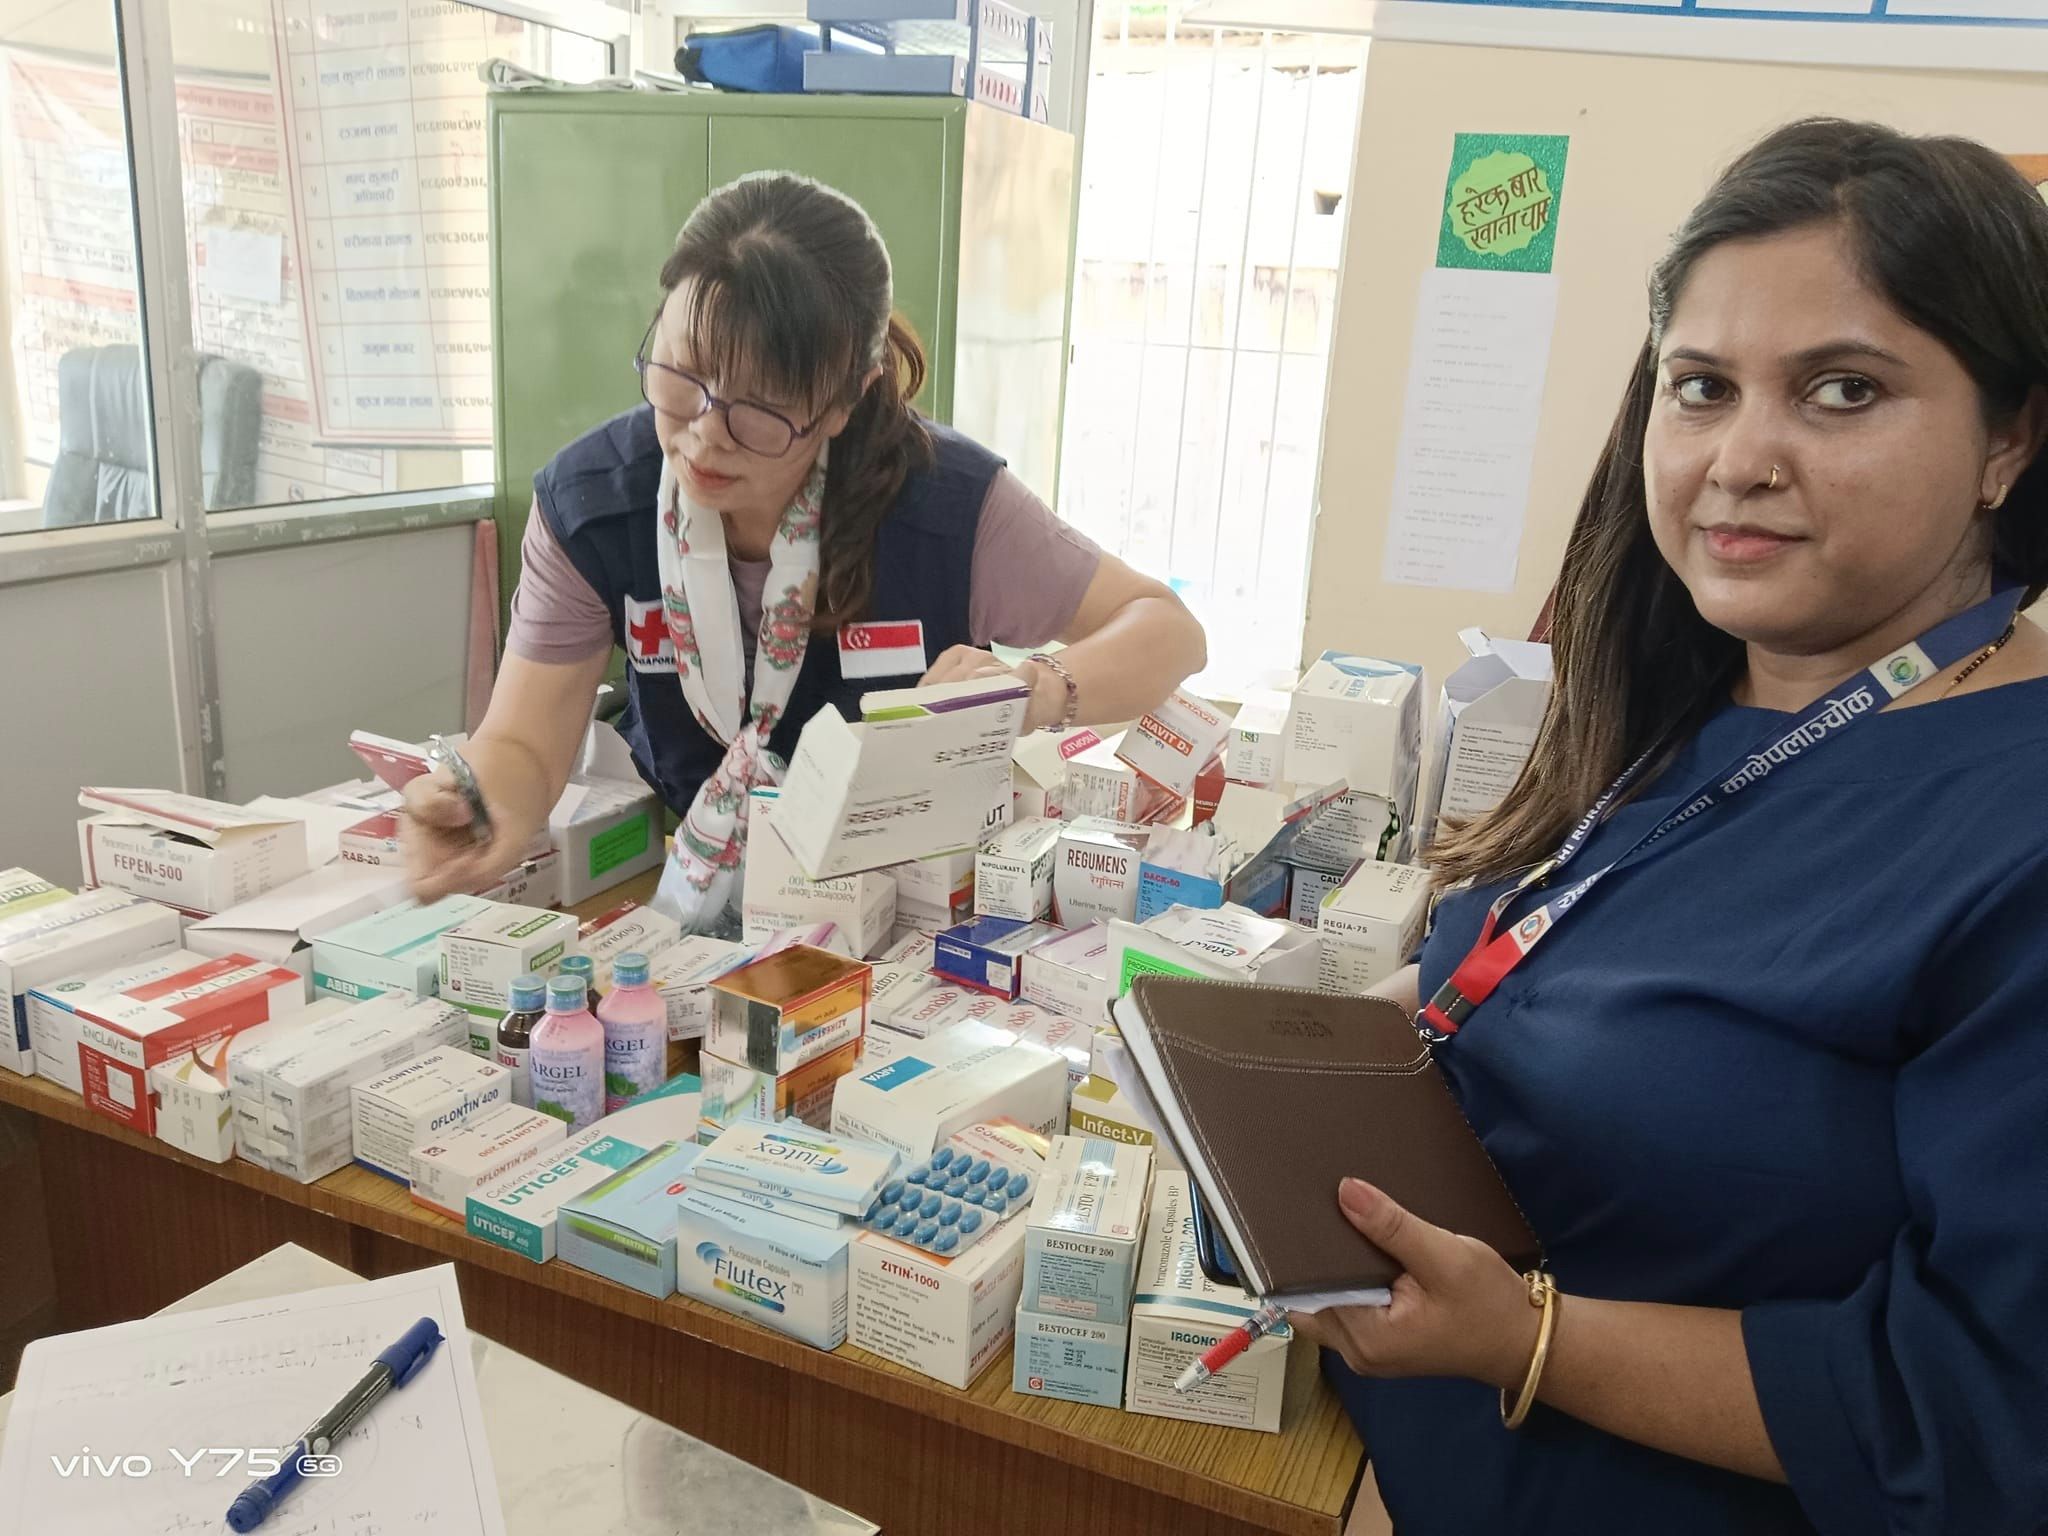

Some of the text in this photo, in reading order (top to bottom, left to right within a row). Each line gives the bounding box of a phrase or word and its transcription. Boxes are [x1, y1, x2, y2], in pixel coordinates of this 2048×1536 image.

[1508, 167, 1545, 198] बार
[1142, 718, 1176, 742] HAVIT
[1557, 843, 1575, 863] HI
[1571, 791, 1614, 841] RURAL
[114, 853, 183, 882] FEPEN-500
[341, 851, 381, 866] RAB-20
[1067, 849, 1128, 876] REGUMENS
[1069, 898, 1119, 915] Uterine Tonic
[1323, 920, 1368, 934] REGIA-75
[326, 977, 358, 997] ABEN
[82, 1025, 126, 1055] ENCLAVE
[369, 1063, 423, 1091] OFLONTIN
[531, 1056, 587, 1079] ARGEL
[866, 1066, 896, 1081] ARYA
[431, 1088, 499, 1132] OFLONTIN 400
[500, 1118, 549, 1150] OFLONTIN
[1082, 1116, 1145, 1146] Infect-V
[589, 1141, 614, 1156] 400
[752, 1141, 836, 1168] Flutex
[476, 1155, 520, 1187] OFLONTIN
[485, 1167, 540, 1200] Cefixime
[580, 1129, 601, 1149] USP
[497, 1157, 581, 1206] UTICEF
[472, 1216, 516, 1241] UTICEF
[1153, 1185, 1180, 1289] Itraconazole Capsules BP
[1046, 1239, 1114, 1257] BESTOCEF 200
[714, 1257, 787, 1301] Flutex
[762, 1259, 791, 1278] Capsules
[881, 1260, 940, 1291] ZITIN-1000
[1038, 1323, 1106, 1340] BESTOCEF 200
